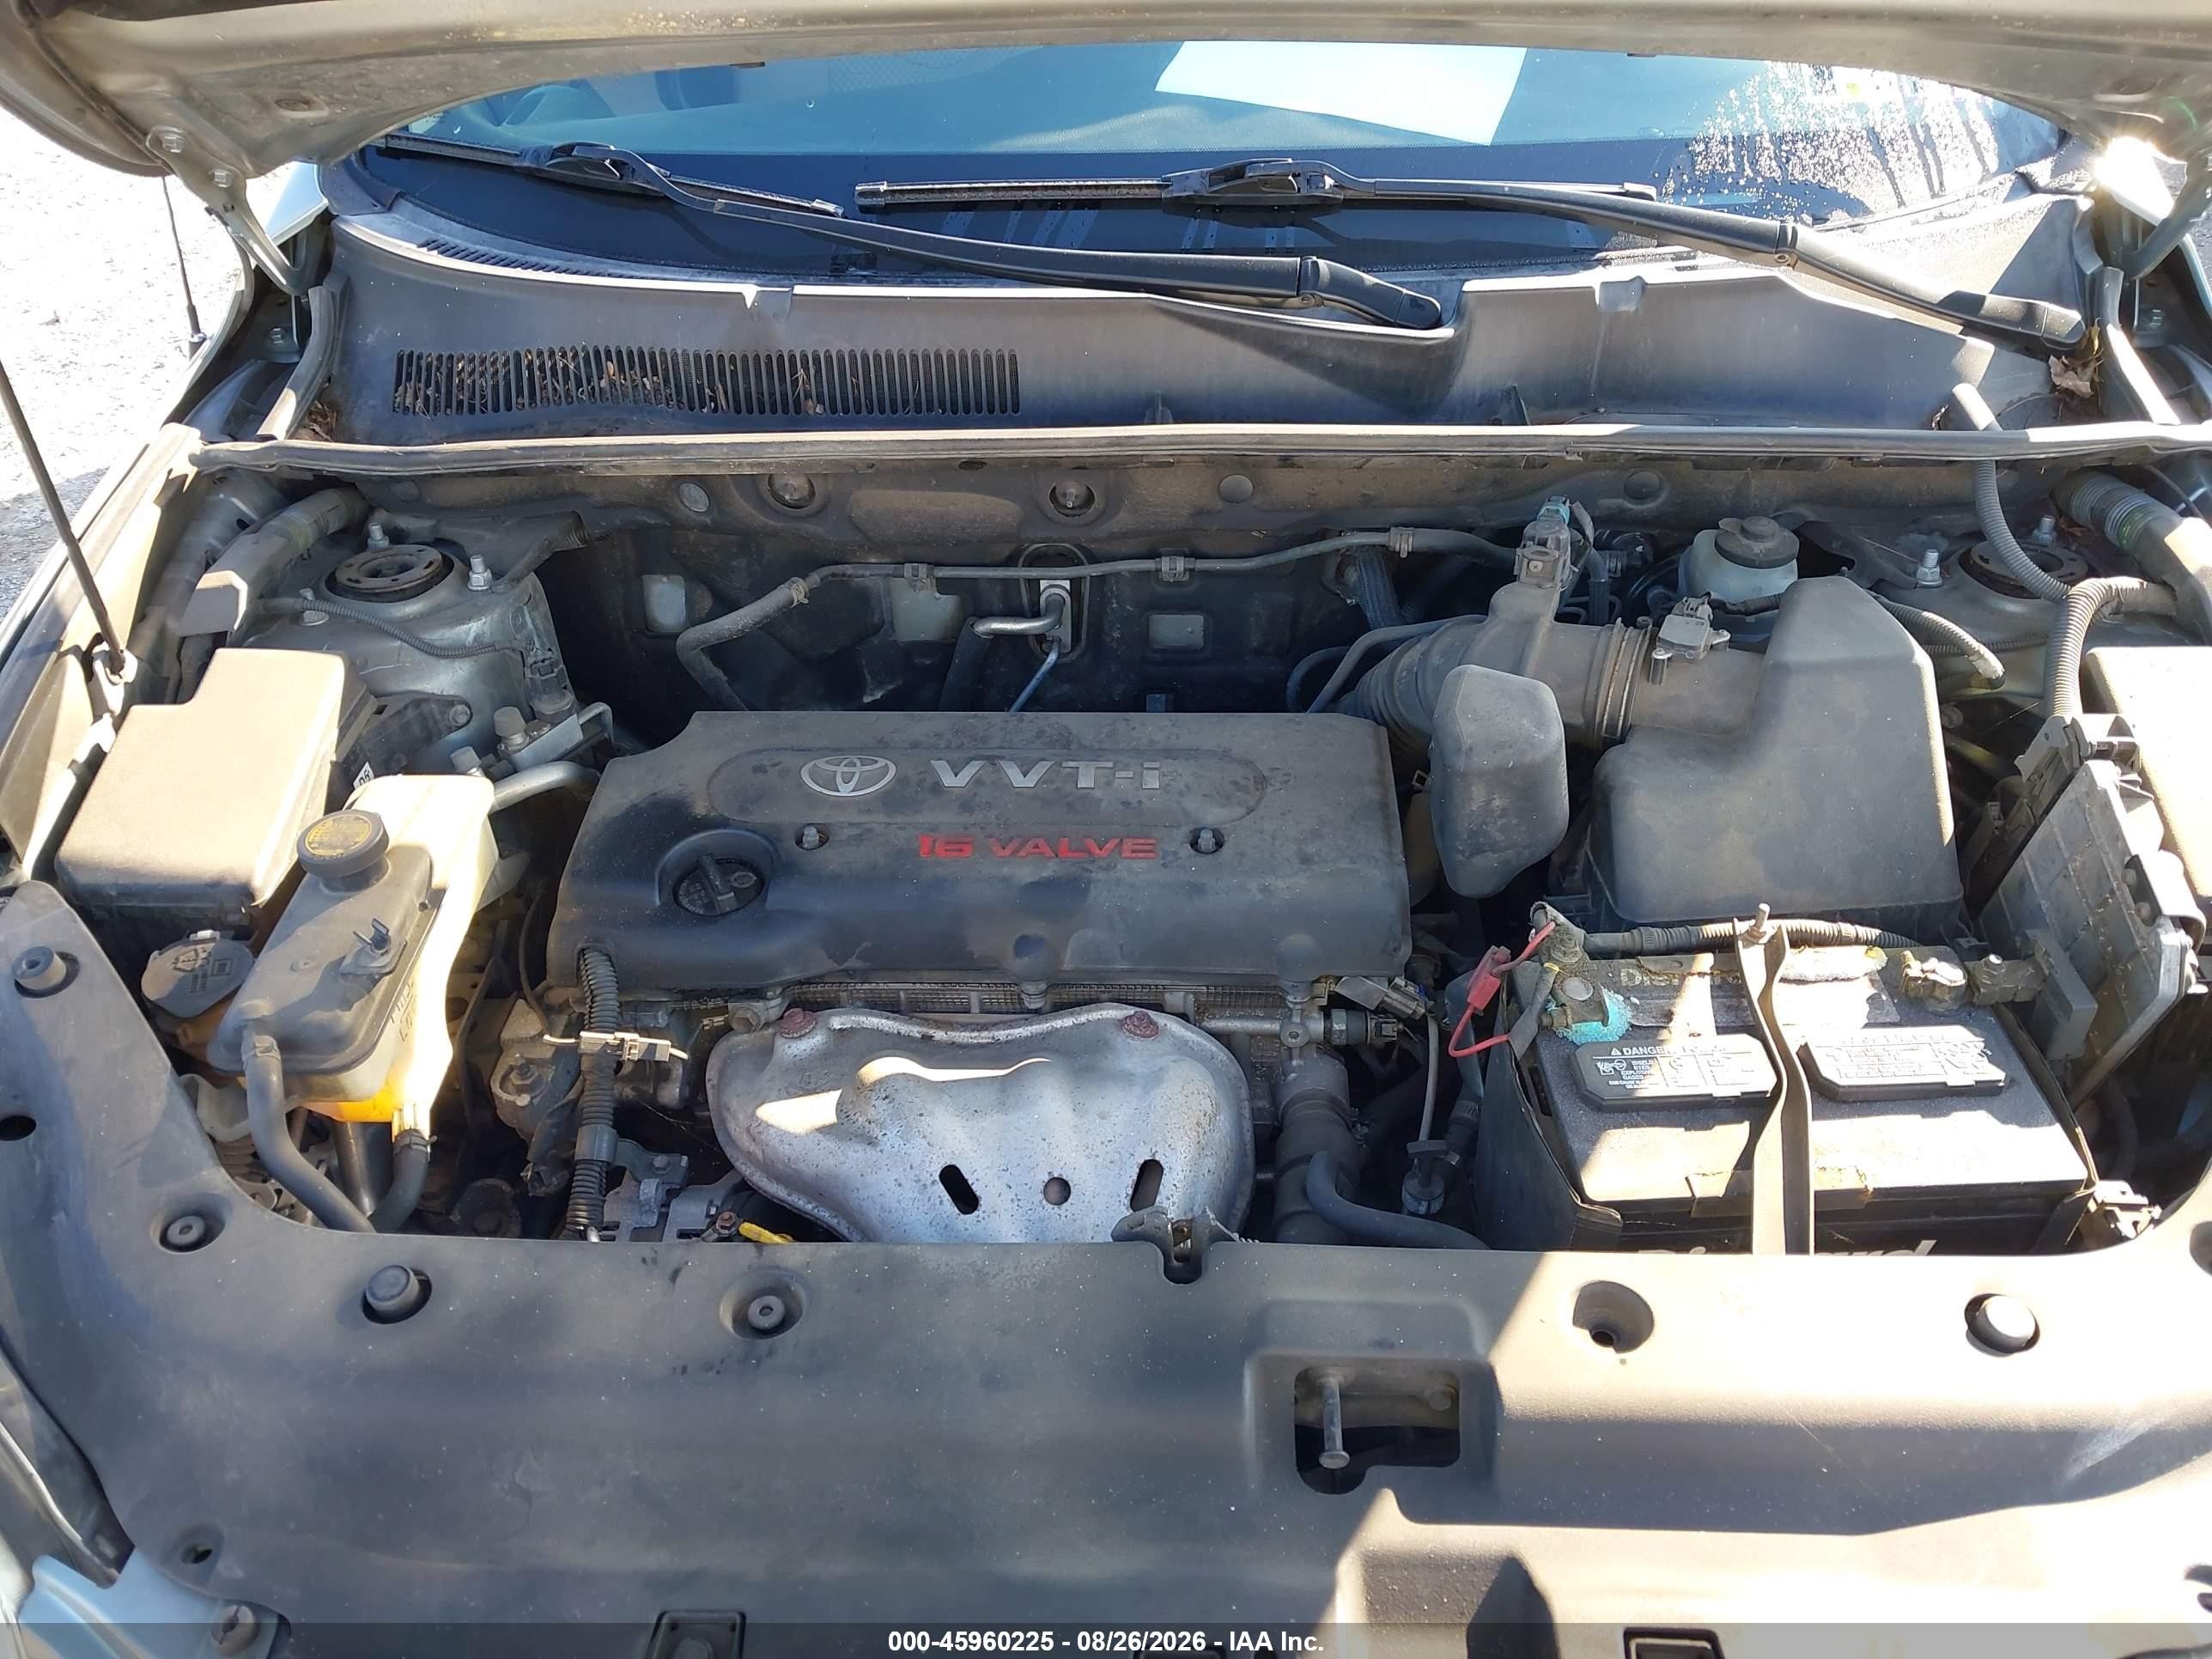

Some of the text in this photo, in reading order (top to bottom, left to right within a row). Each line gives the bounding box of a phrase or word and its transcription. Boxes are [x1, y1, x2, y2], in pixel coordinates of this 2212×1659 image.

[929, 759, 1160, 790] VVT-i
[918, 835, 1159, 859] 16 VALVE
